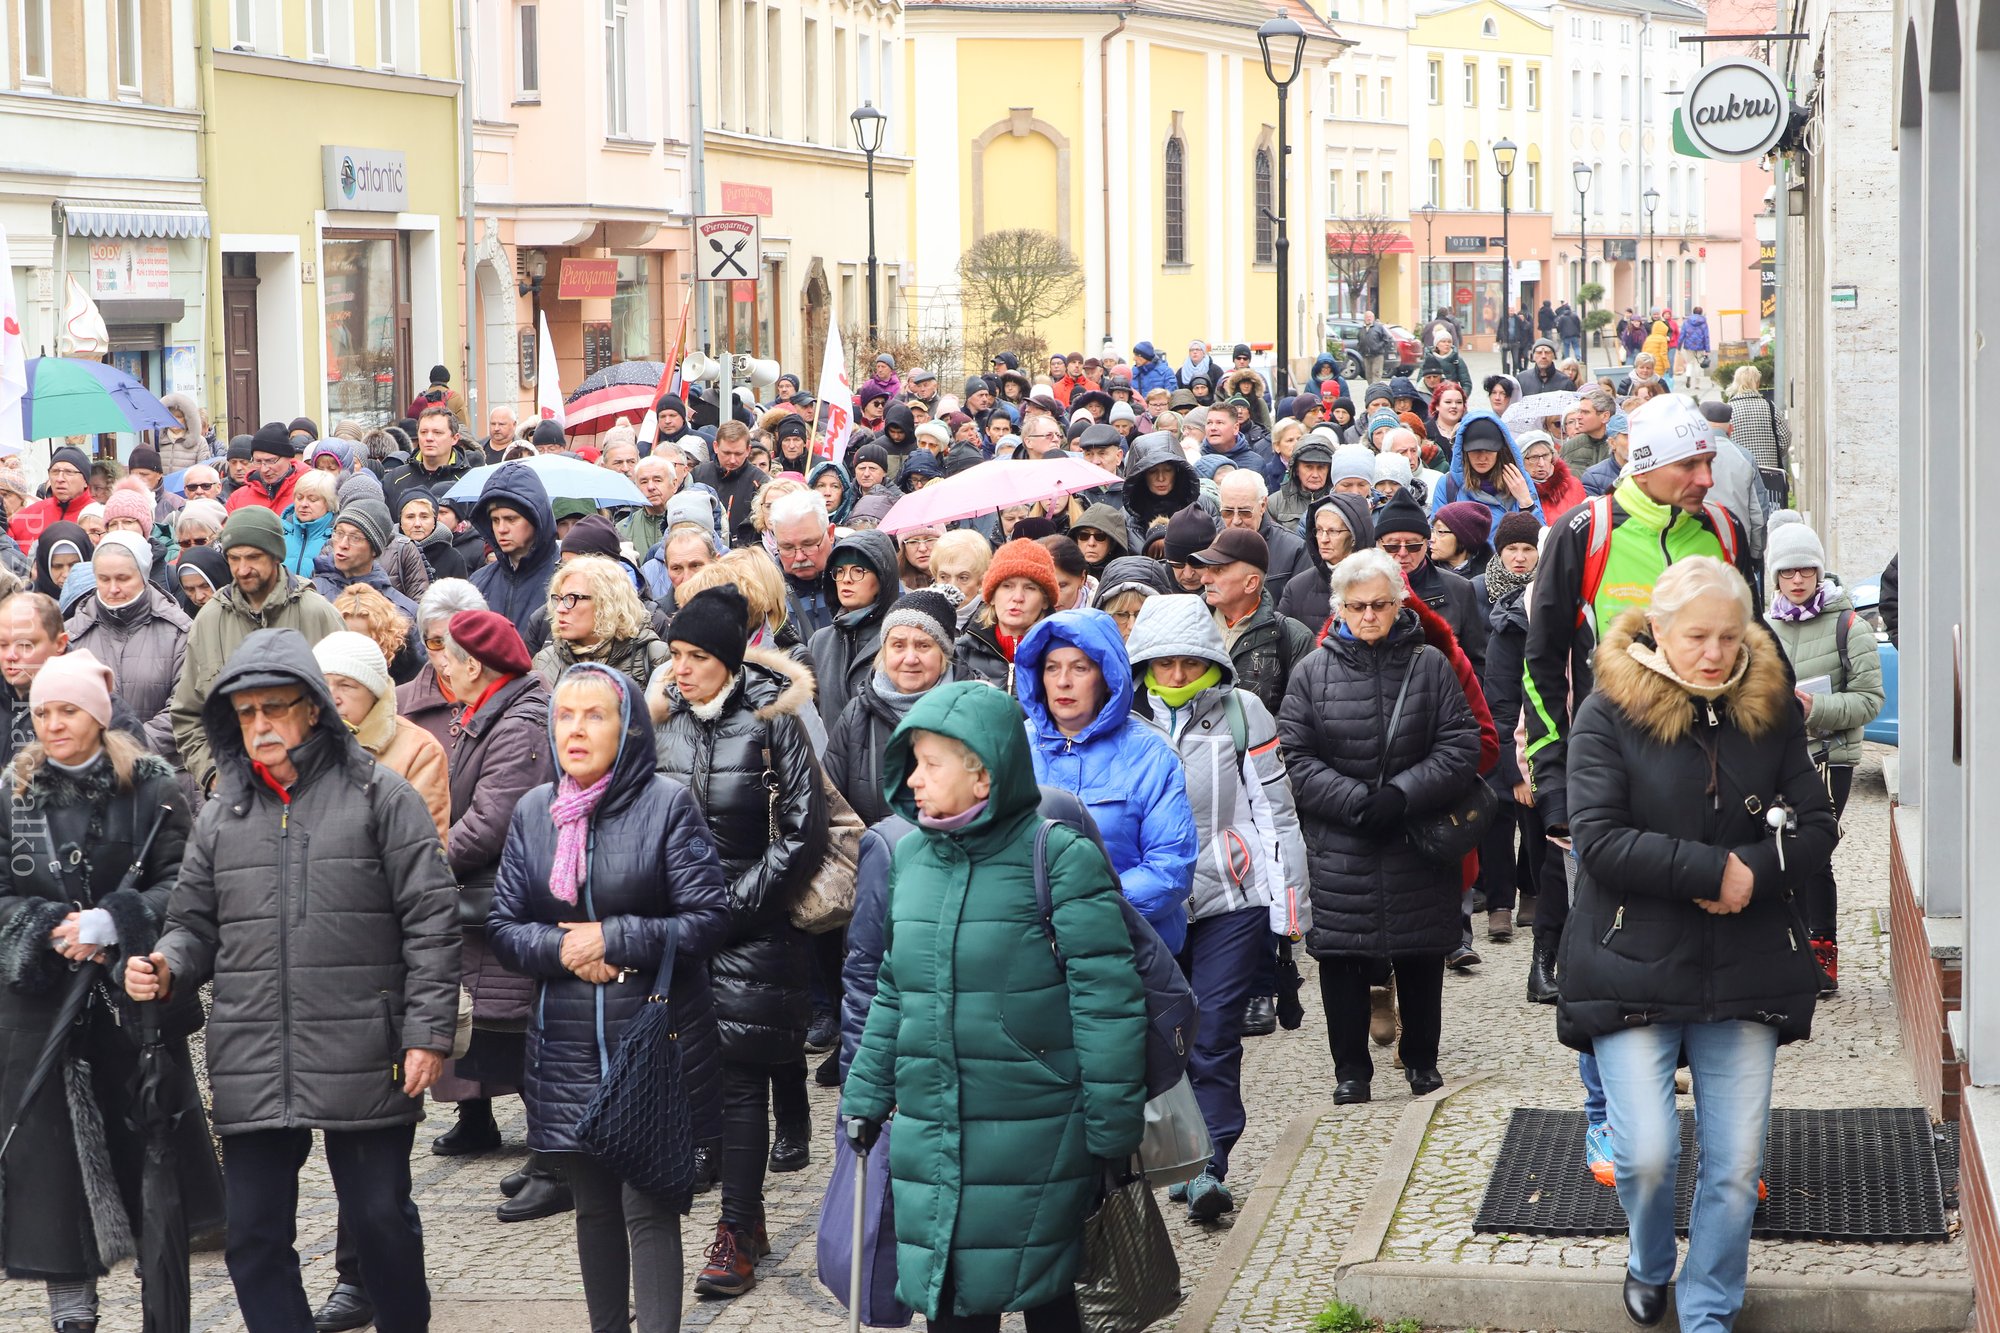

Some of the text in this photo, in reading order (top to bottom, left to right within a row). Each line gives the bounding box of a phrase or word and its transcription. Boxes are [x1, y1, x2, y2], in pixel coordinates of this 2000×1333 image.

[1695, 93, 1775, 125] cukru
[357, 161, 403, 193] atlantic
[704, 221, 750, 233] Pierogarnia
[90, 244, 121, 260] LODY
[562, 264, 617, 292] Pierogarnia
[1675, 414, 1709, 438] DNB
[1633, 446, 1651, 460] DNB
[1634, 458, 1657, 472] swix
